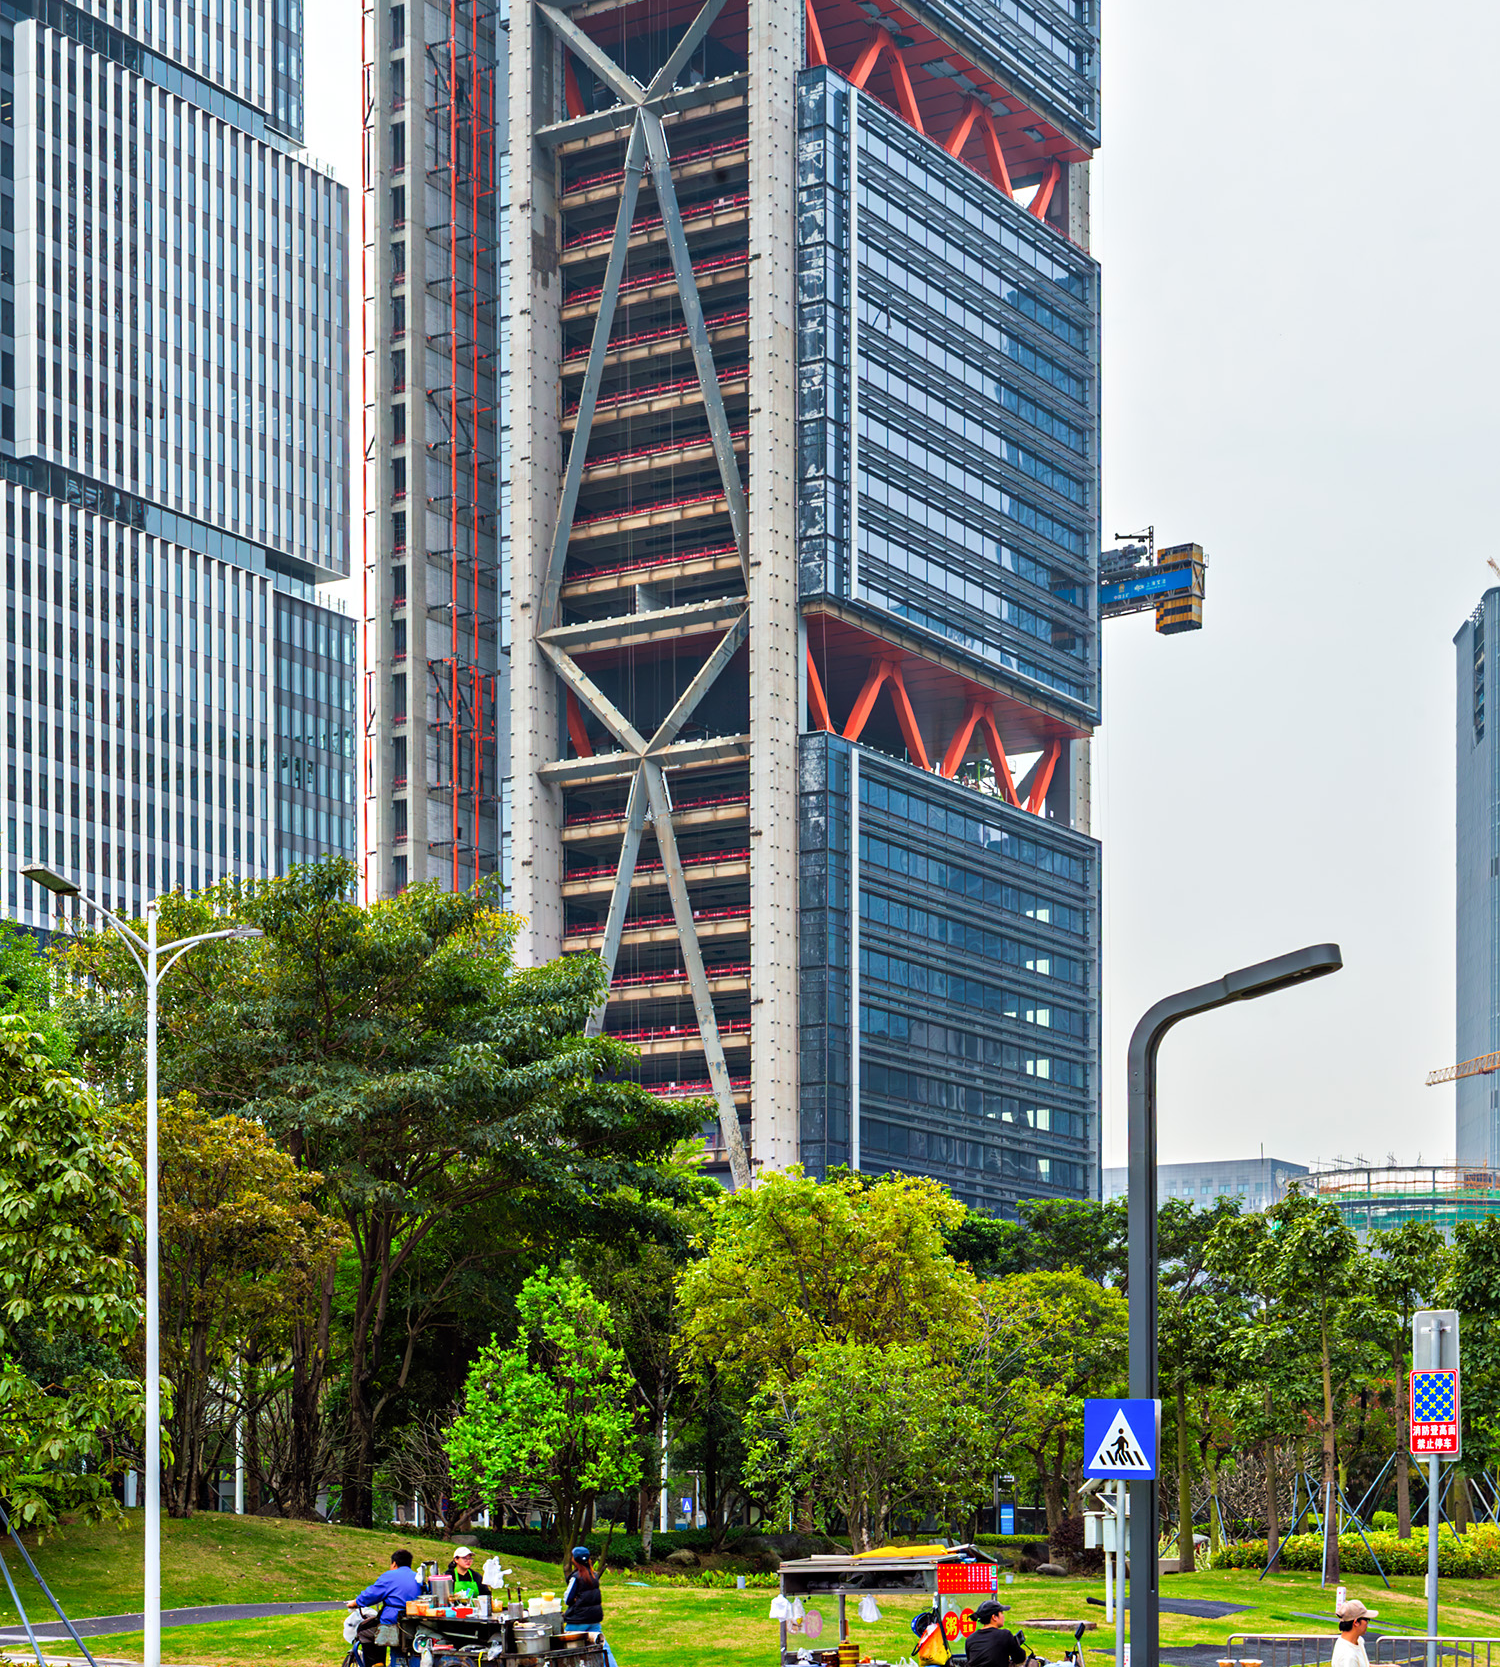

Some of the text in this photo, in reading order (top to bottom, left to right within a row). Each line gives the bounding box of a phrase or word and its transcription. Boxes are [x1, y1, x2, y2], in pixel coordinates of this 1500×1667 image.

[1412, 1424, 1456, 1436] 消防登高面
[1417, 1438, 1452, 1449] 禁止停车
[945, 1616, 958, 1636] 粥
